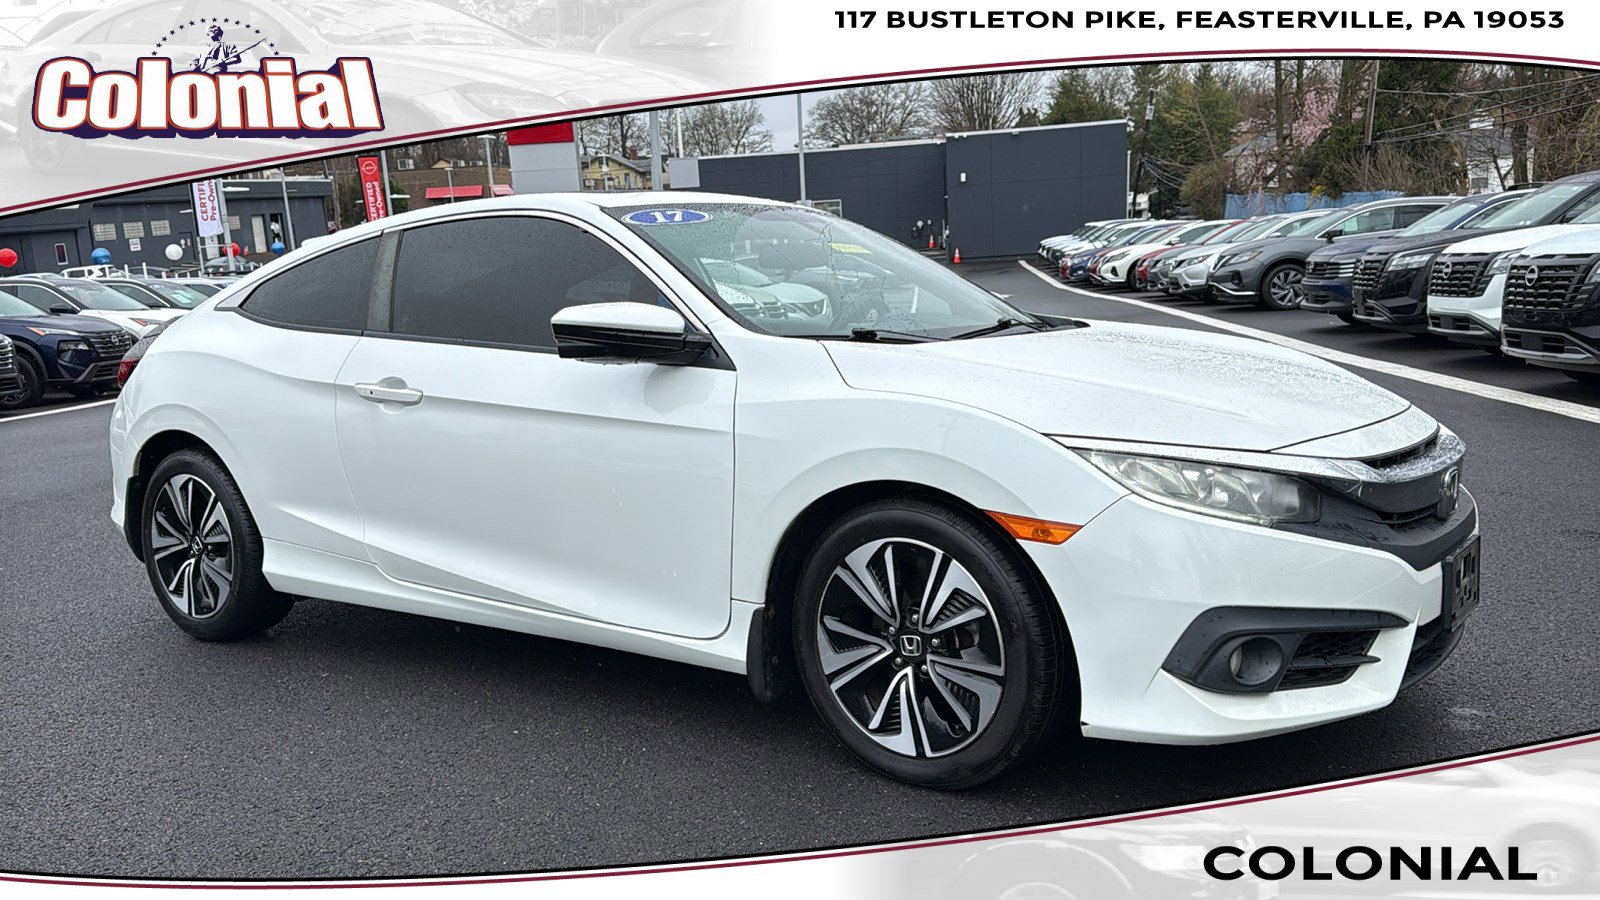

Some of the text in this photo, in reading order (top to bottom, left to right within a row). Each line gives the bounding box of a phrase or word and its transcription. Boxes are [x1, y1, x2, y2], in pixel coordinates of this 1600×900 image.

[197, 181, 209, 221] CERTIFI
[207, 180, 217, 222] Pre-Own
[650, 210, 683, 223] 17
